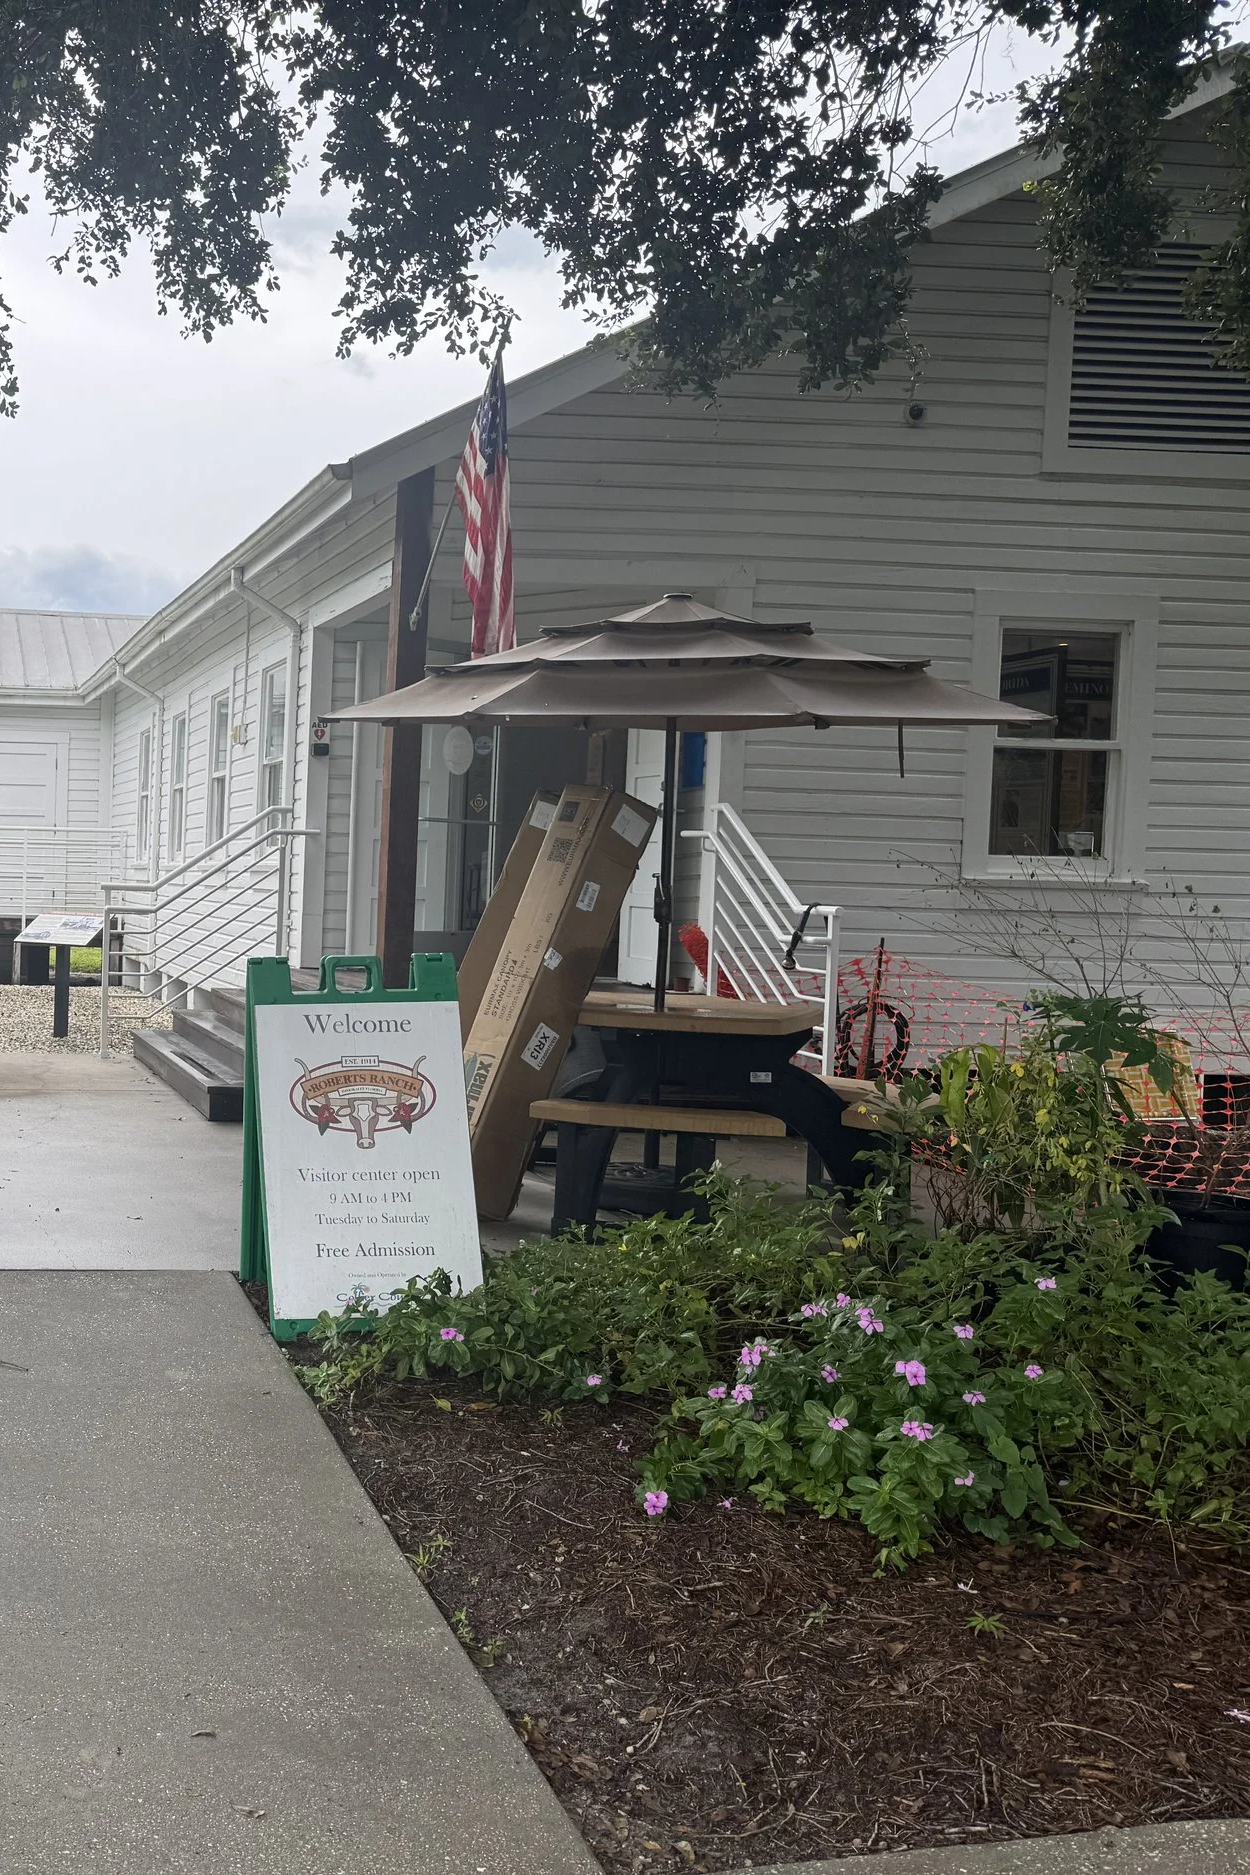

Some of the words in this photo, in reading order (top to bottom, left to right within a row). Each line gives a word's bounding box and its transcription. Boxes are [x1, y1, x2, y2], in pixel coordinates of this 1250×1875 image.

[497, 950, 512, 982] CANOPY
[303, 1013, 412, 1034] Welcome
[310, 1074, 368, 1093] ROBERTS
[369, 1074, 413, 1090] RANCH
[298, 1168, 348, 1182] Visitor
[352, 1169, 398, 1181] center
[402, 1170, 440, 1183] open
[329, 1193, 337, 1204] 9
[340, 1192, 362, 1204] AM
[366, 1194, 378, 1203] to
[380, 1192, 387, 1203] 4
[391, 1191, 412, 1203] PM
[315, 1213, 363, 1226] Tuesday
[366, 1214, 378, 1224] to
[381, 1212, 430, 1225] Saturday
[316, 1243, 350, 1258] Free
[355, 1241, 436, 1257] Admission
